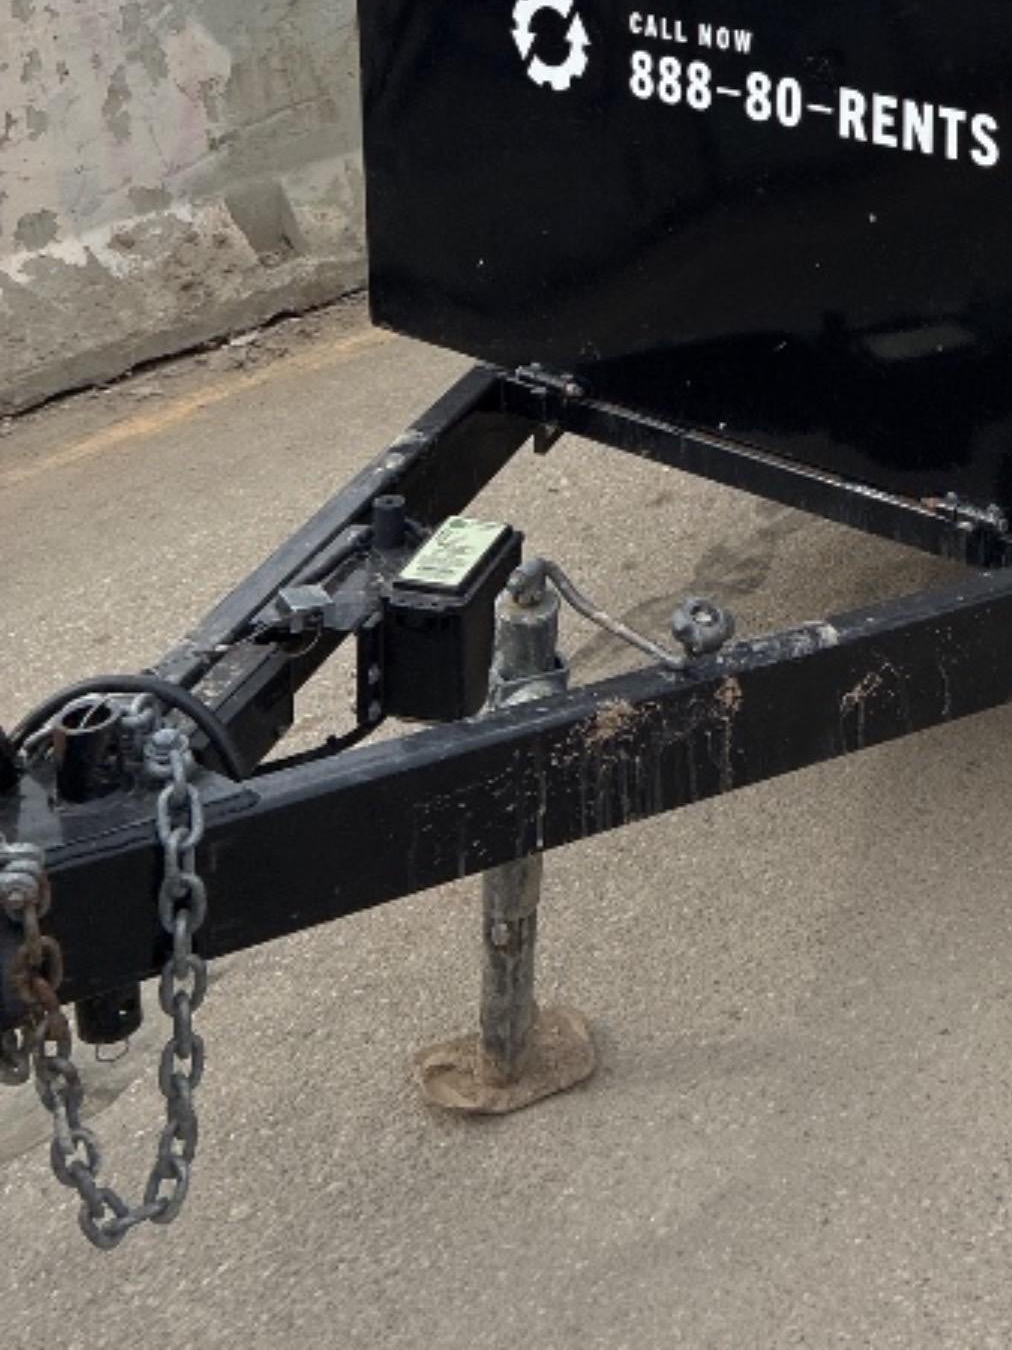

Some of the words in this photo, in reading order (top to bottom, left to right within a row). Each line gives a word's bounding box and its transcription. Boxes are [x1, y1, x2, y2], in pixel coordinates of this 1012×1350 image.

[629, 11, 688, 43] CALL
[698, 23, 753, 55] NOW
[629, 50, 1000, 168] 888-80-RENTS
